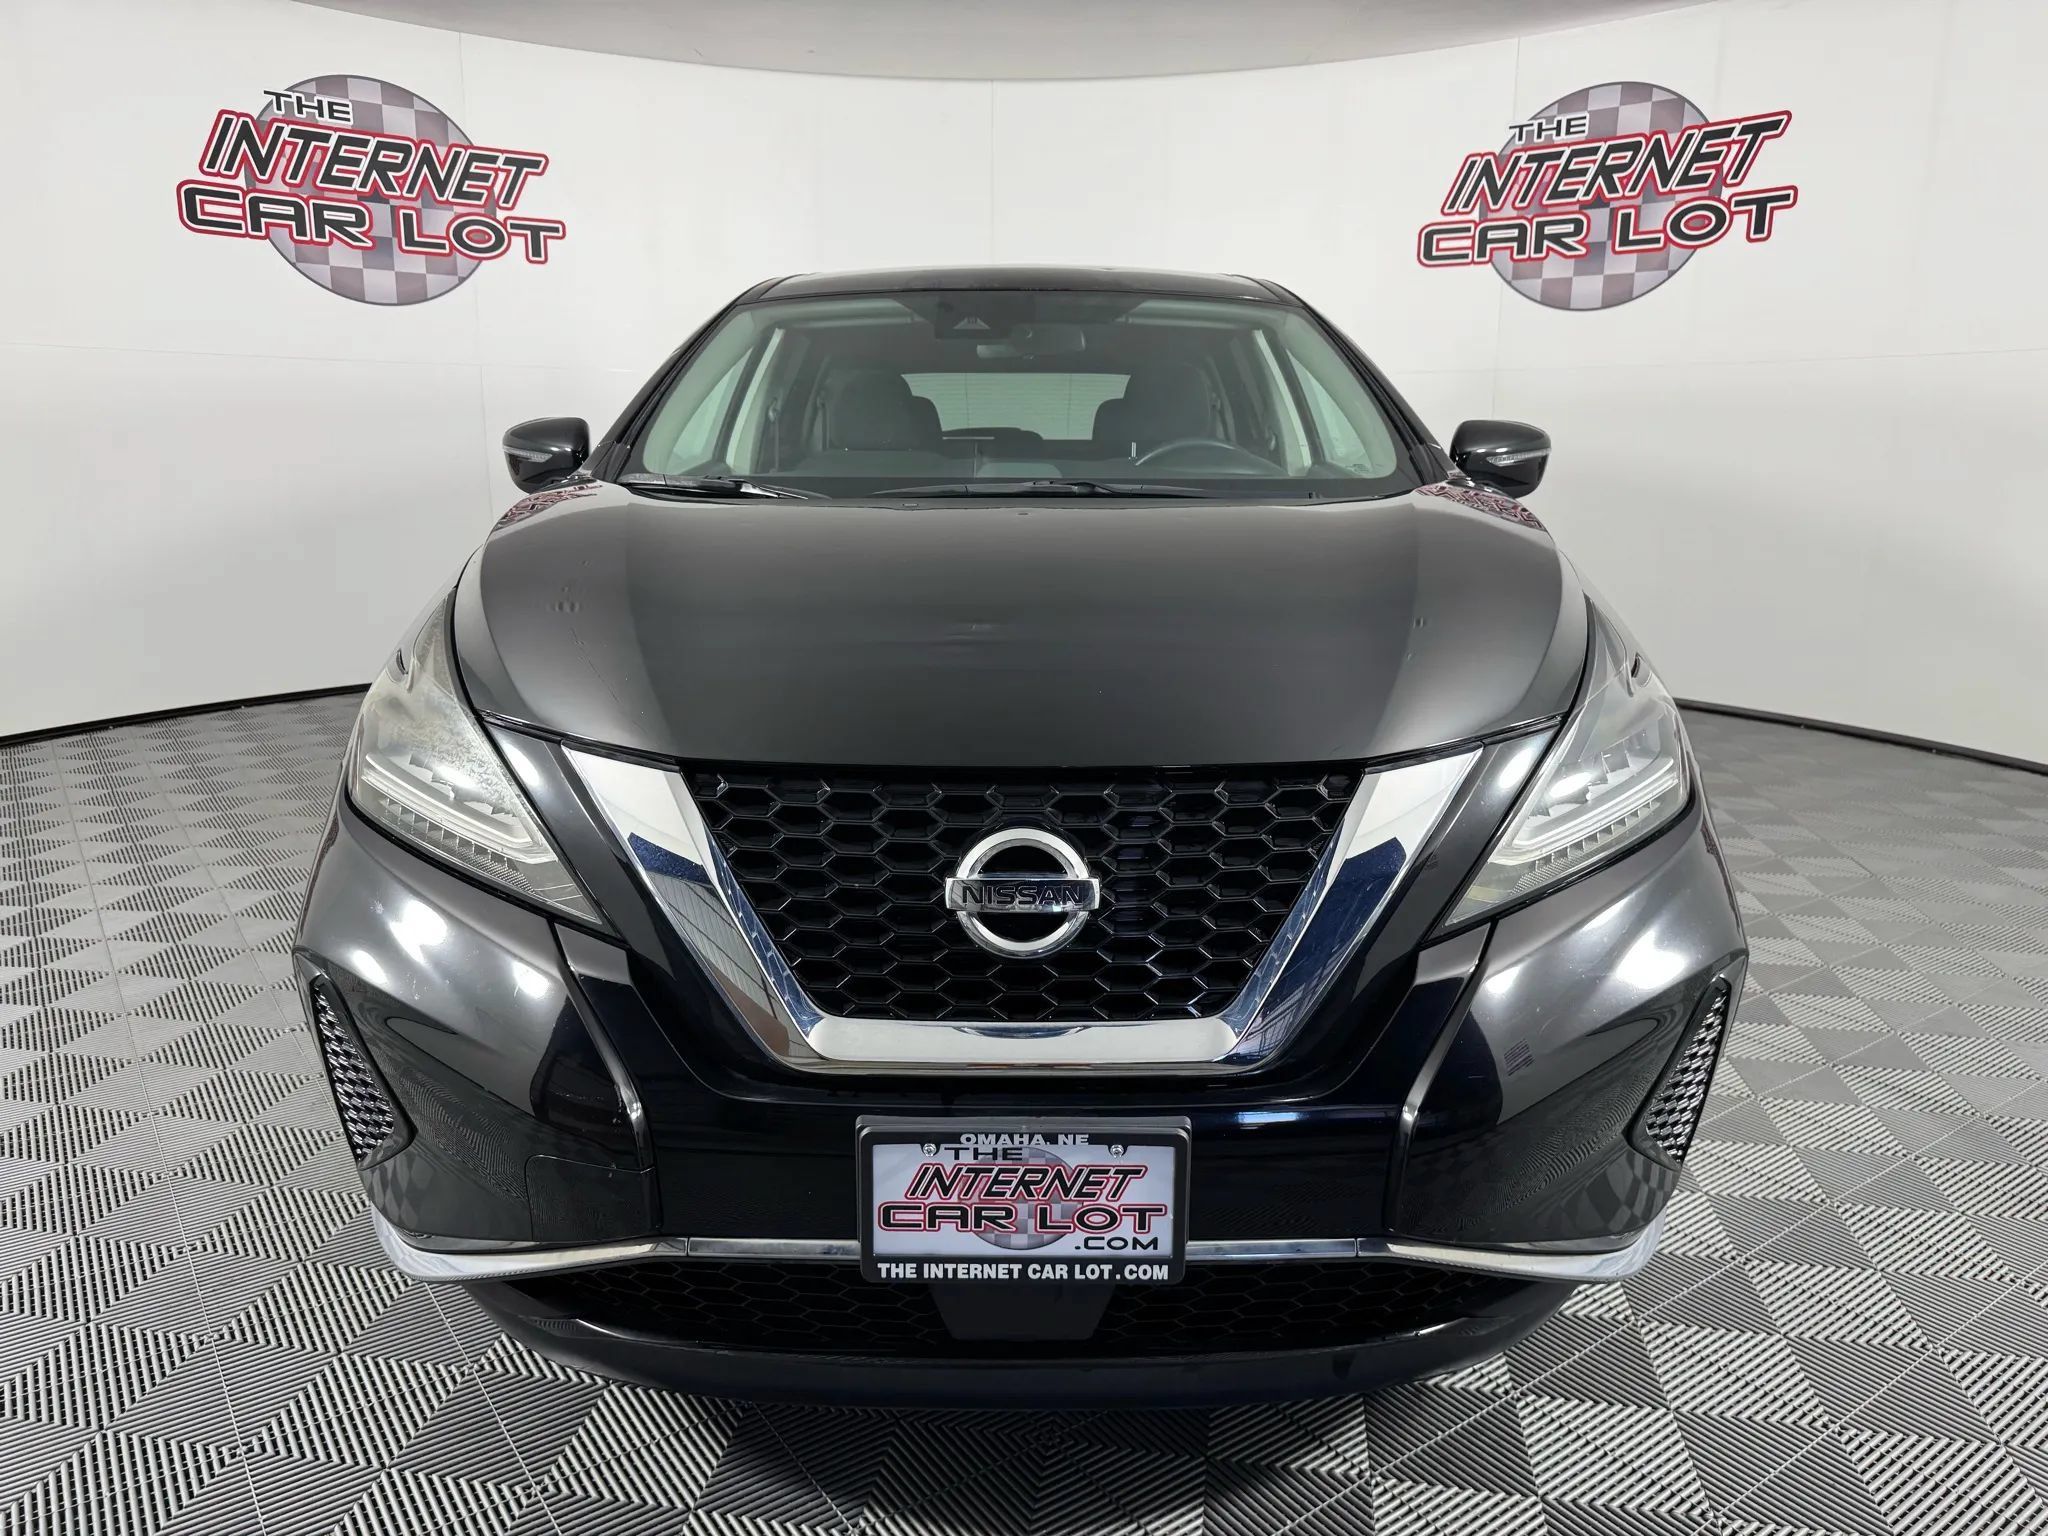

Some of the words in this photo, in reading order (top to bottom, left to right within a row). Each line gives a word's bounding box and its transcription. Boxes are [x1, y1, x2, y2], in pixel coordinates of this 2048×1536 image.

[263, 90, 353, 122] THE
[1509, 112, 1590, 144] THE
[199, 109, 549, 208] INTERNET
[1441, 110, 1792, 215] INTERNET
[177, 180, 375, 250] CAR
[397, 206, 566, 264] LOT
[1418, 210, 1591, 267] CAR
[1611, 185, 1799, 254] LOT
[962, 885, 1083, 905] NISSAN
[944, 1147, 1023, 1161] THE
[1057, 1133, 1089, 1146] NE
[905, 1163, 1147, 1201] INTERNET
[878, 1202, 1018, 1233] CAR
[1033, 1202, 1168, 1234] LOT
[1074, 1236, 1158, 1251] .COM
[877, 1263, 917, 1279] THE
[923, 1264, 1022, 1279] INTERNET
[1027, 1264, 1068, 1280] CAR
